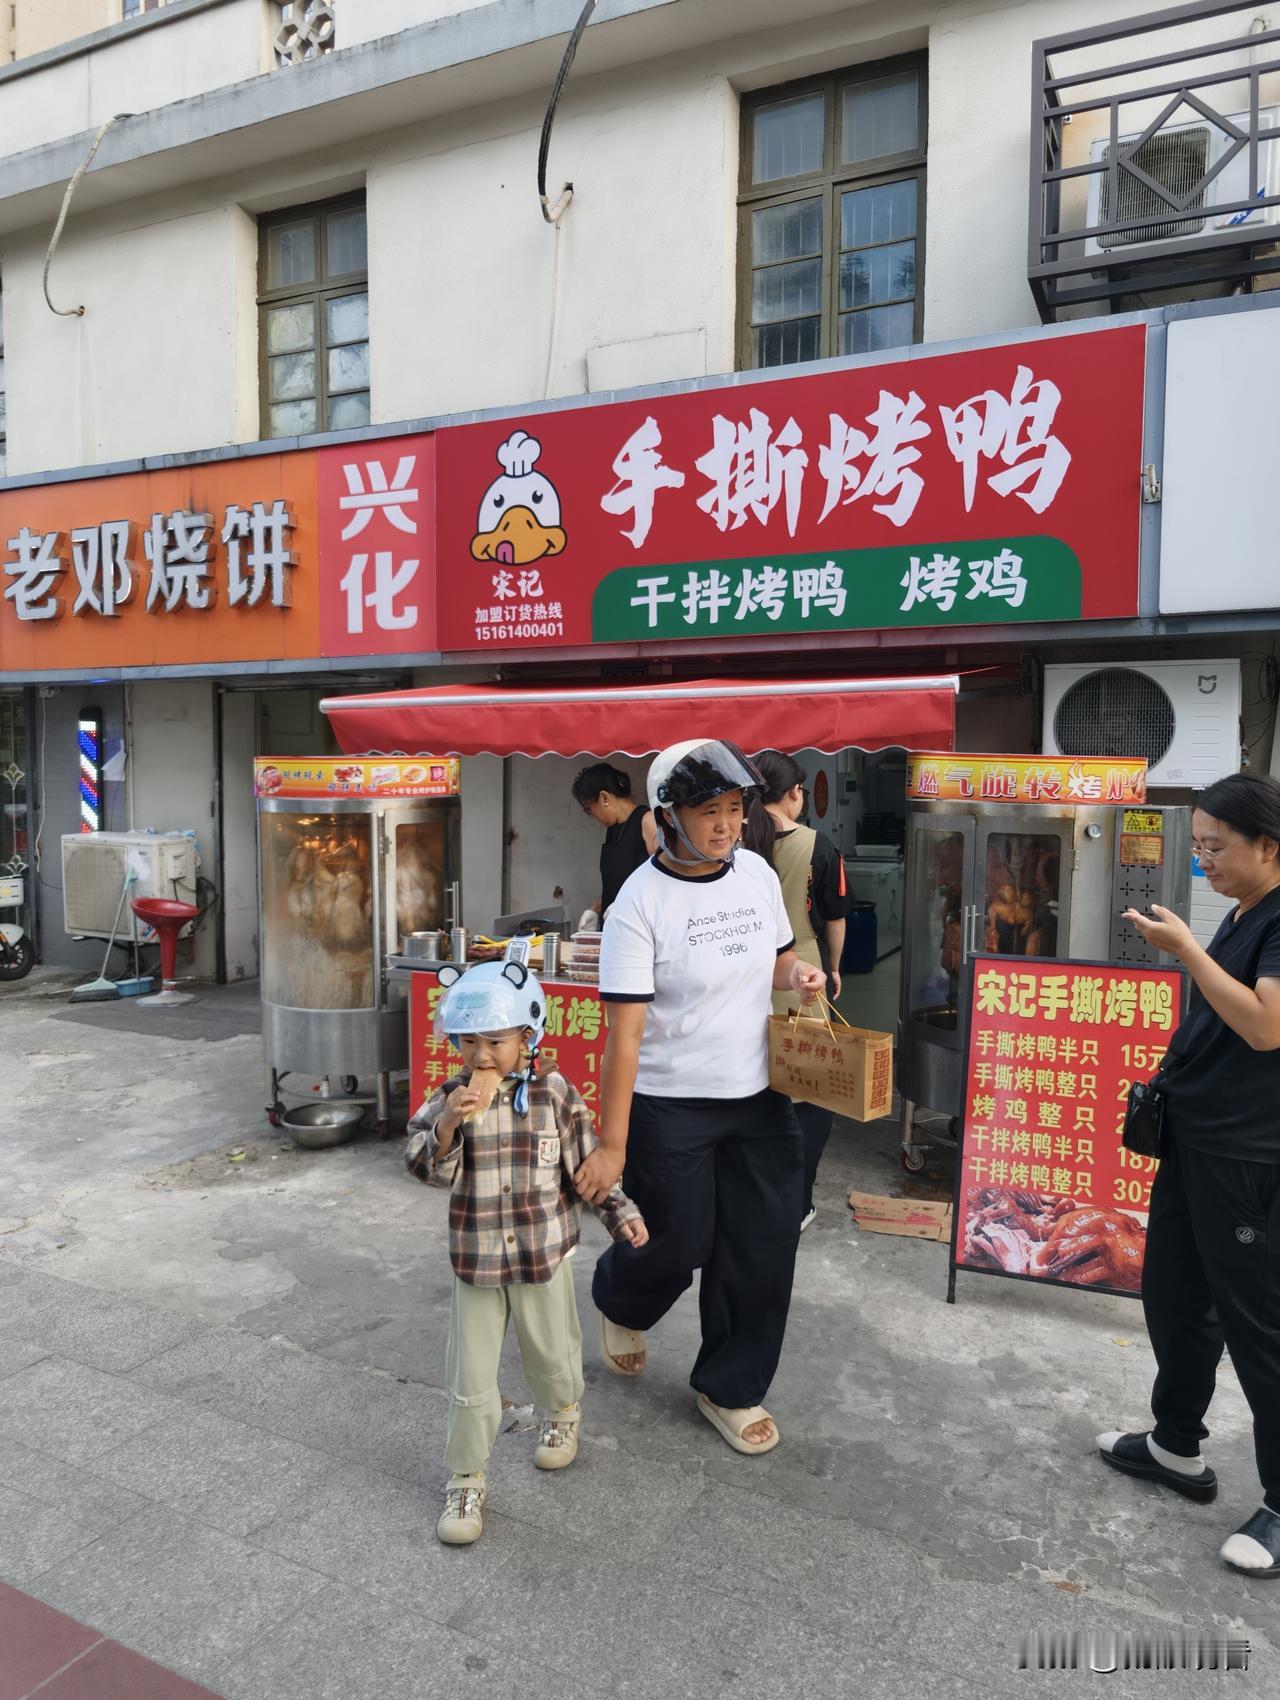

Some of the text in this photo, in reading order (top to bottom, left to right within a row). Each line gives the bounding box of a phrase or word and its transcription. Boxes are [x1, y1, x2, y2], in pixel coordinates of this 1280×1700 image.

[601, 365, 1072, 549] 手撕烤鸭
[3, 500, 299, 622] 老邓烧饼
[339, 454, 419, 634] 兴化
[491, 569, 544, 601] 宋记
[630, 548, 1028, 630] 干拌烤鸭 烤鸡
[475, 602, 563, 623] 加盟订货热线
[475, 622, 563, 640] 15161400401
[717, 907, 756, 922] Studios
[688, 921, 764, 947] STOCKHOLM
[720, 943, 748, 957] 1996
[976, 969, 1173, 1031] 宋记手撕烤鸭
[975, 1029, 1099, 1066] 手撕烤鸭半只
[973, 1062, 1098, 1100] 手撕烤鸭整只
[971, 1093, 1094, 1132] 烤鸡整只
[970, 1125, 1093, 1165] 干拌烤鸭半只
[968, 1156, 1093, 1199] 干拌烤鸭整只
